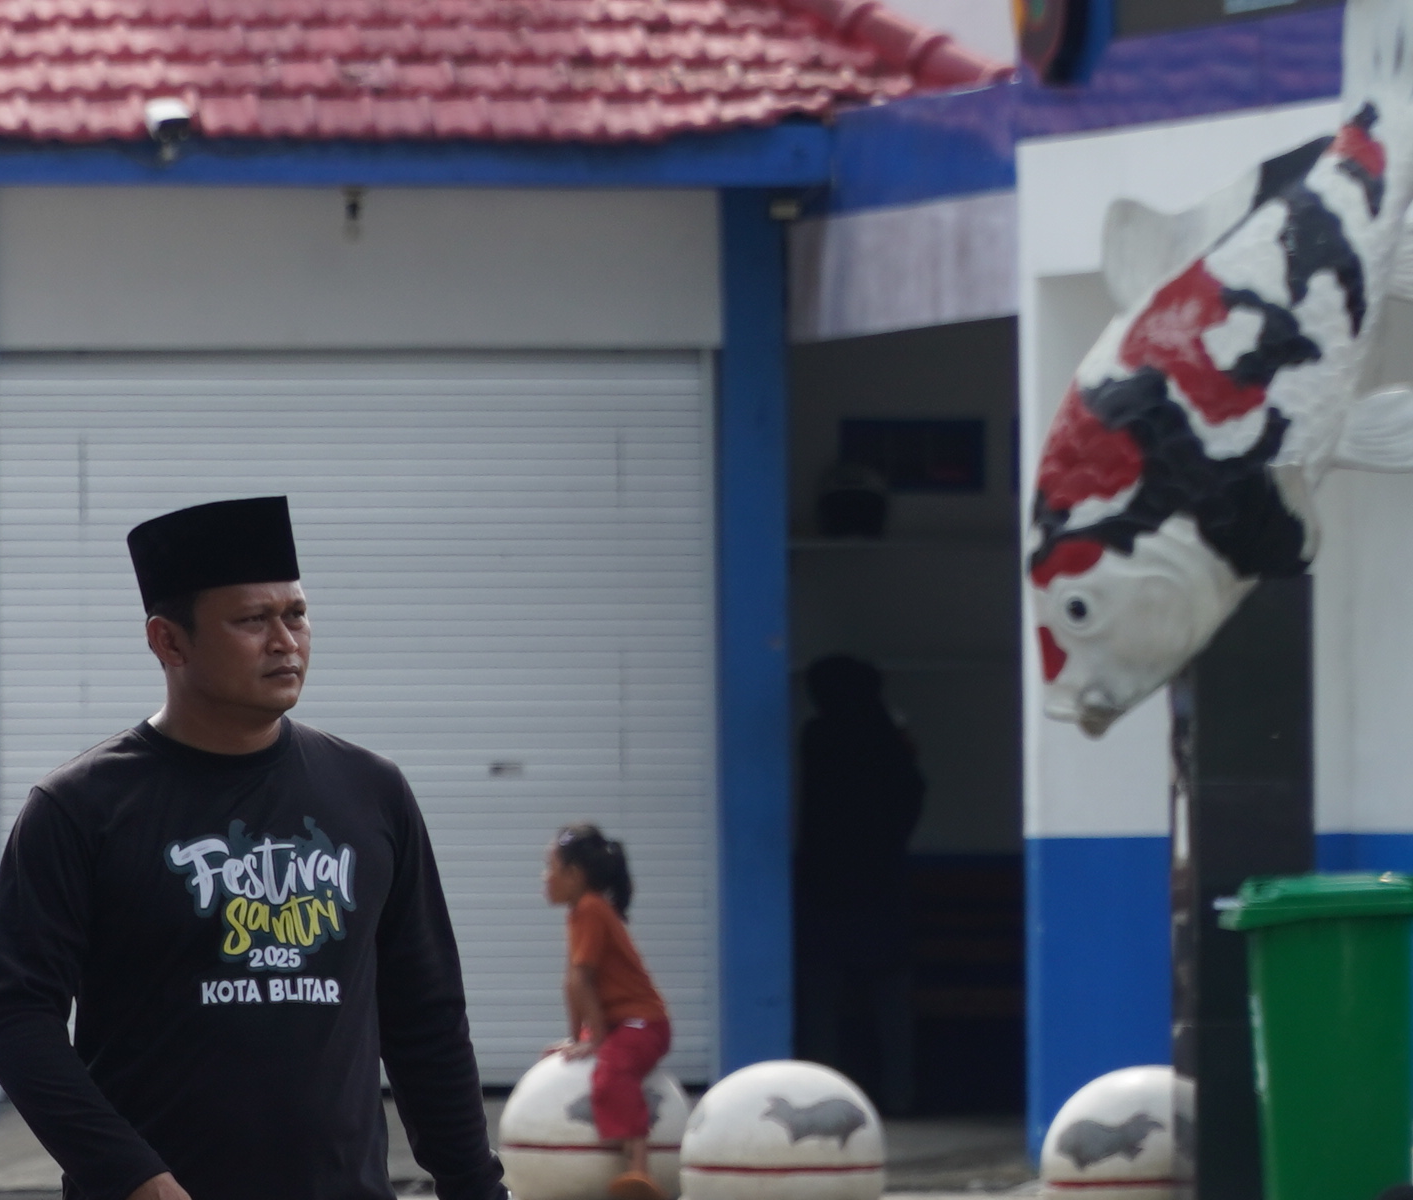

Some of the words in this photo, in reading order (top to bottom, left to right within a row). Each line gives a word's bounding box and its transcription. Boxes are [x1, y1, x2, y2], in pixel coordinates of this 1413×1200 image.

[170, 837, 351, 909] Festival
[248, 946, 301, 968] 2025
[201, 979, 262, 1004] KOTA
[268, 977, 340, 1003] BLITAR
